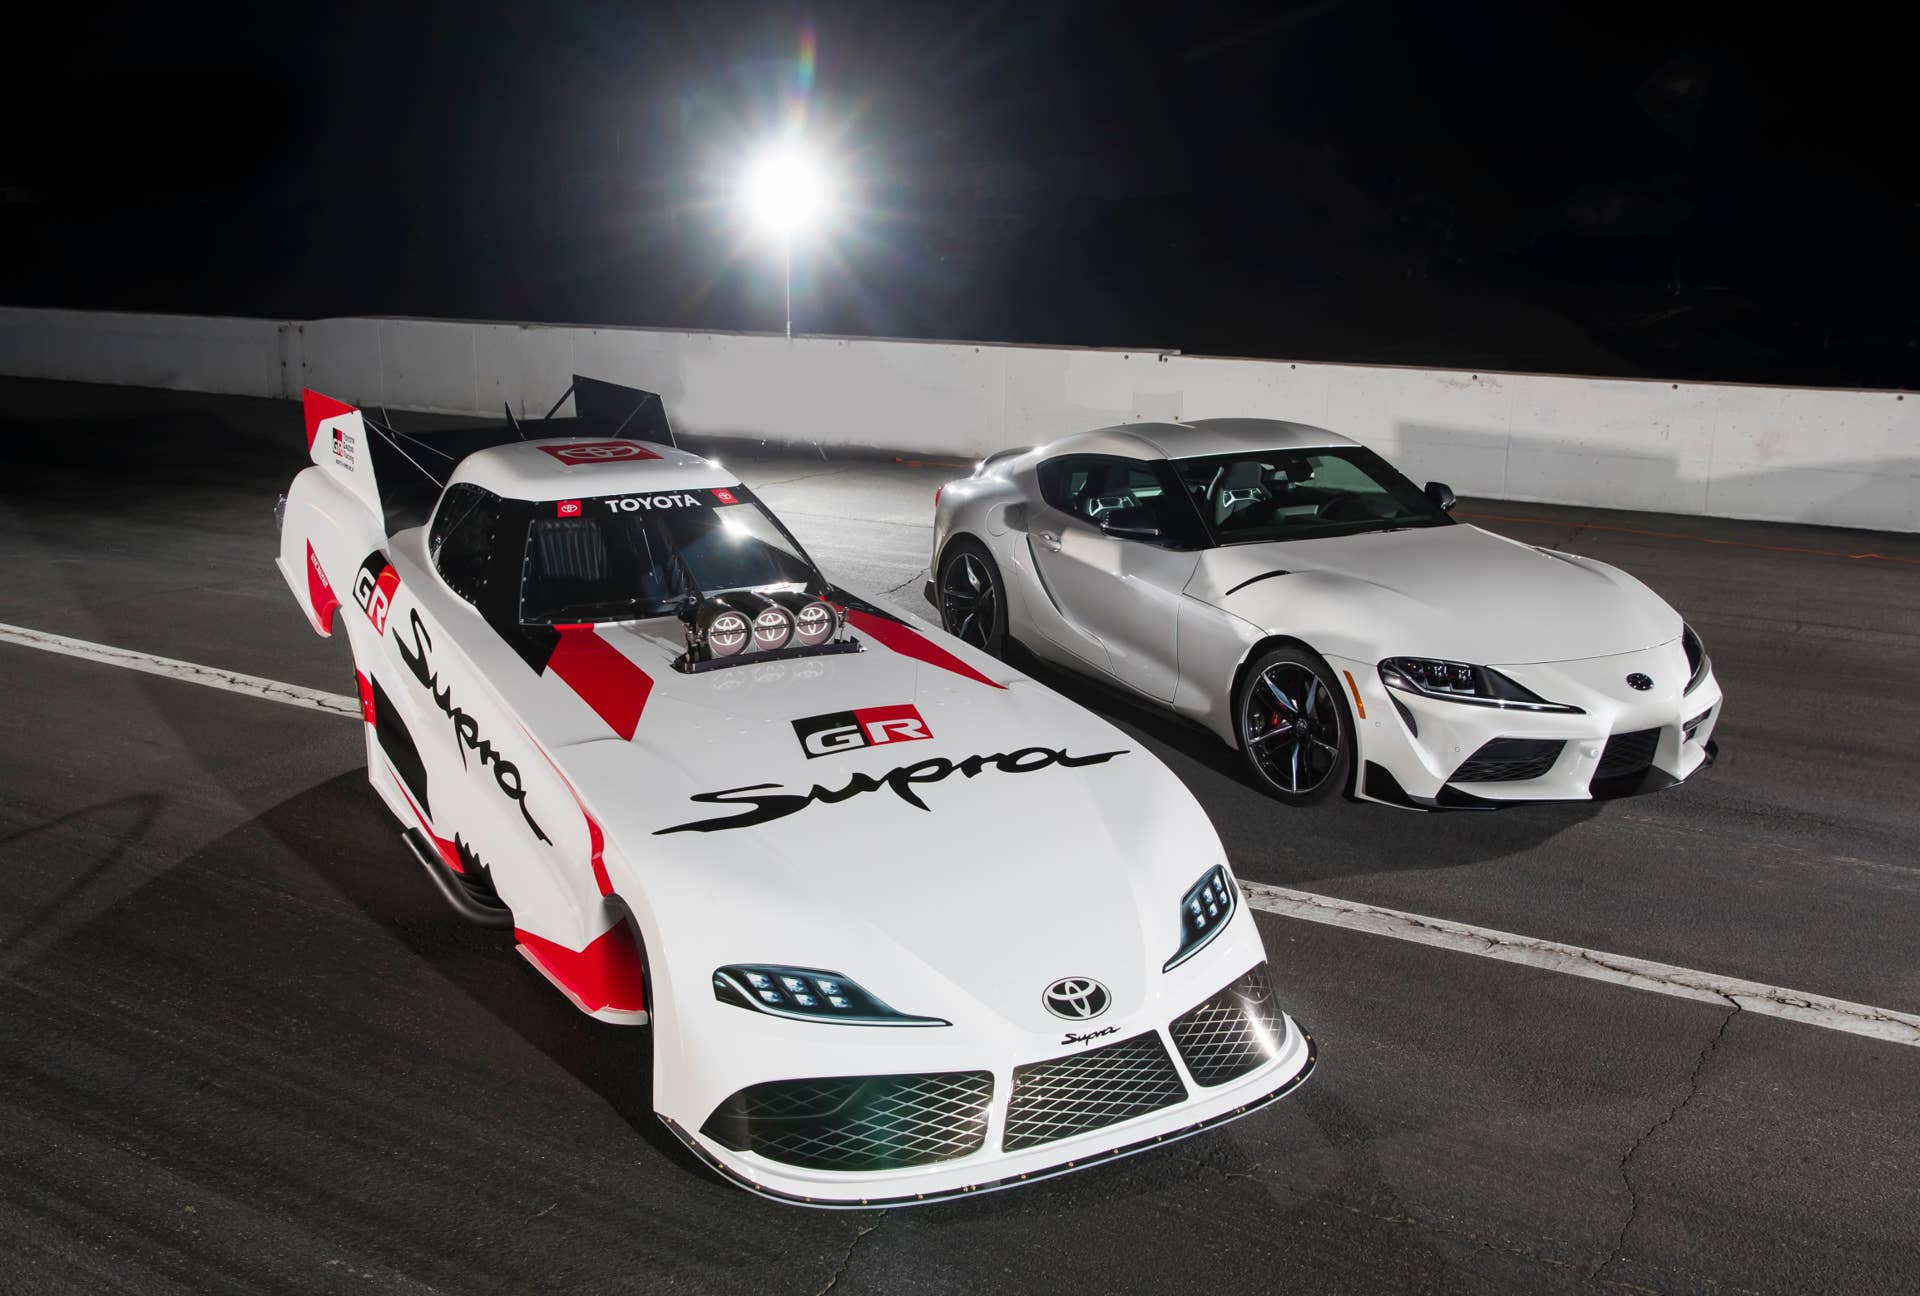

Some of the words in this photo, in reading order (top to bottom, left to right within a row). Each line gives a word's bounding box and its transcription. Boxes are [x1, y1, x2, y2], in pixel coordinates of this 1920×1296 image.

[605, 494, 702, 513] TOYOTA
[354, 566, 389, 633] GR
[392, 608, 554, 847] Supra
[804, 718, 930, 756] GR
[651, 747, 1131, 836] Supra
[1061, 1026, 1121, 1046] Supra
